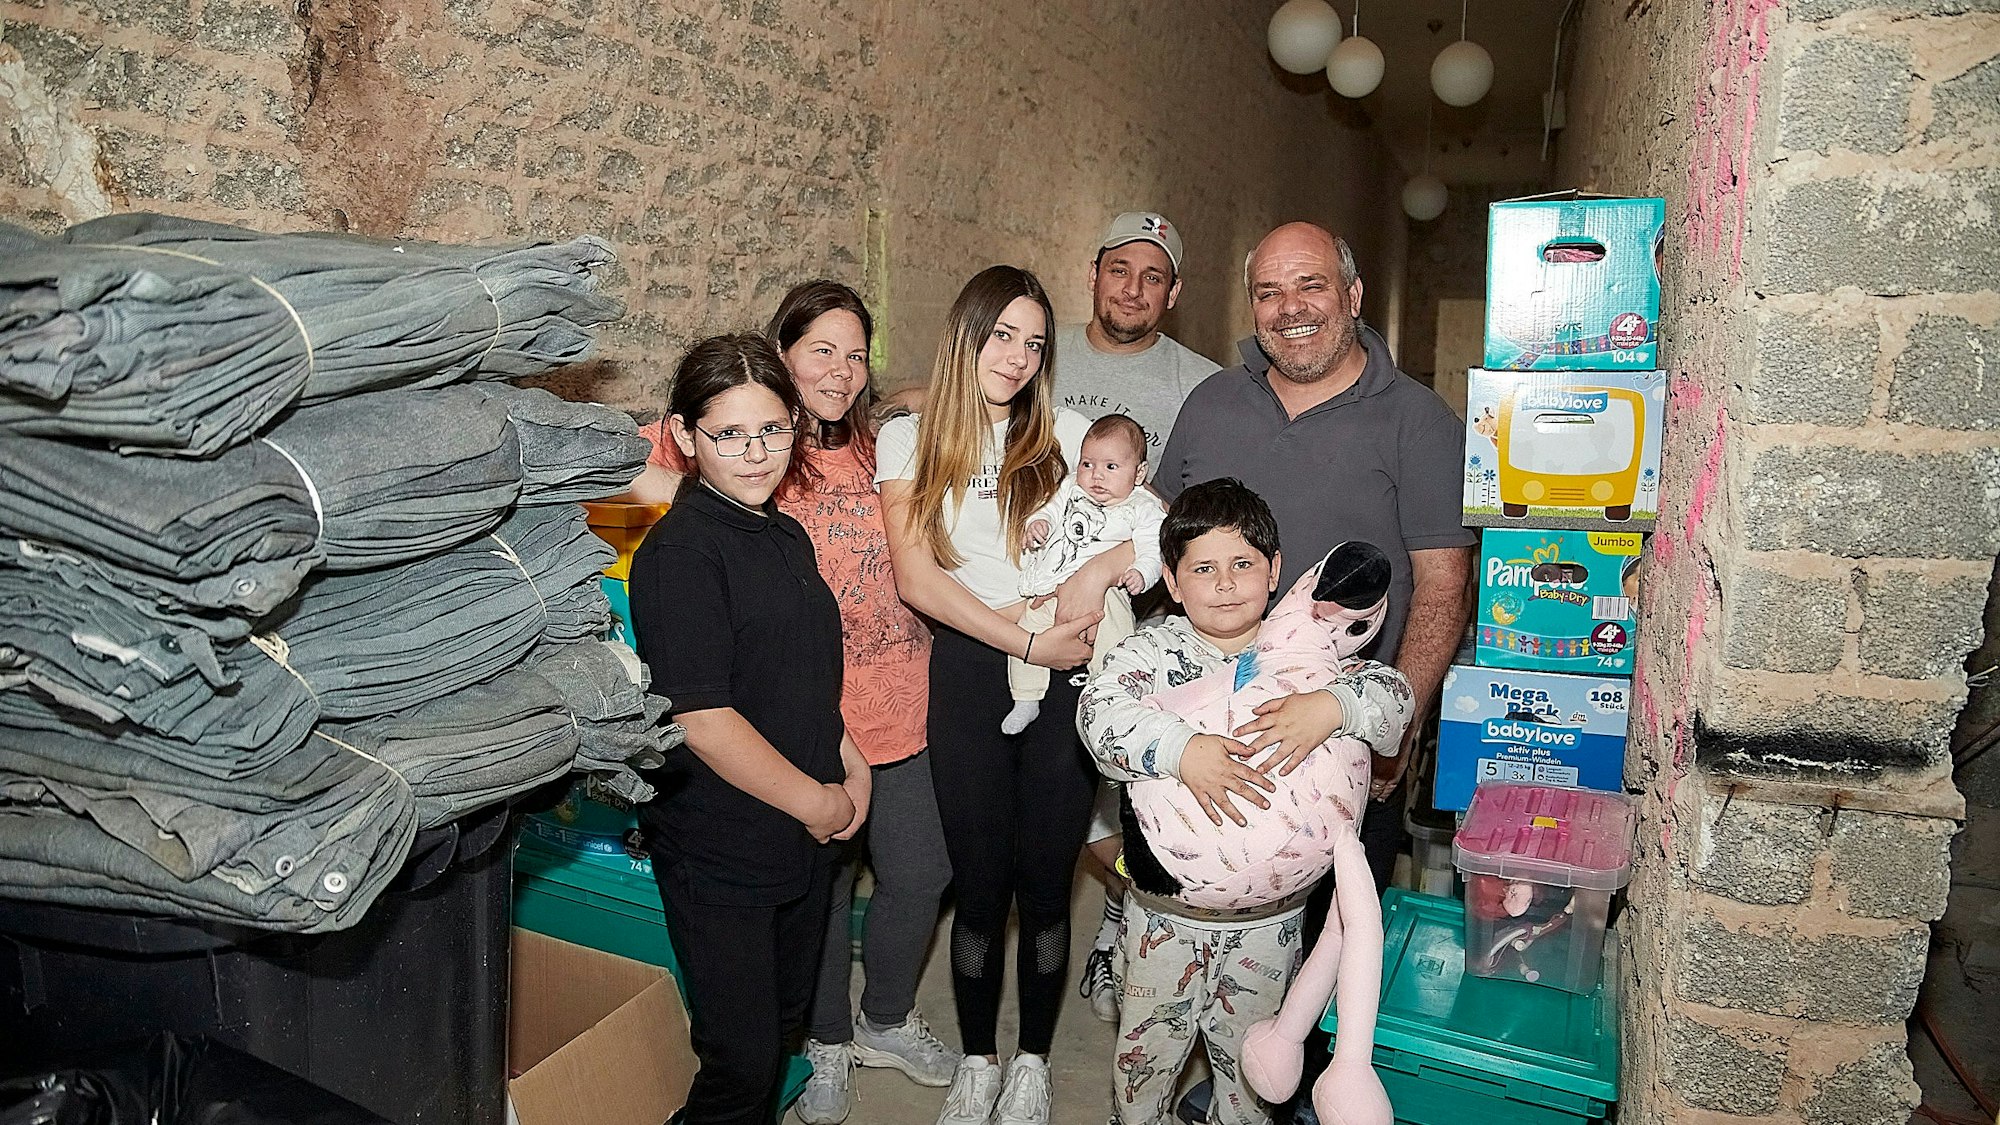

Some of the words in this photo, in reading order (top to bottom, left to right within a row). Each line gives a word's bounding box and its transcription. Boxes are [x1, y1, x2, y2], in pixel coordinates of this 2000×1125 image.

[1611, 351, 1636, 363] 104
[1064, 394, 1109, 408] MAKE
[1114, 403, 1131, 415] IT
[1593, 536, 1635, 547] Jumbo
[1486, 556, 1587, 597] Pamp
[1539, 589, 1588, 607] Baby-Dry
[1597, 656, 1613, 667] 74
[1490, 683, 1549, 706] Mega
[1590, 691, 1623, 703] 108
[1600, 702, 1626, 711] Stück
[1572, 711, 1586, 721] dm
[1487, 721, 1576, 745] babylove
[1507, 746, 1531, 754] aktiv
[1532, 747, 1551, 757] plus
[1496, 752, 1562, 766] Premium-Windeln
[1485, 761, 1498, 776] 5
[1511, 770, 1526, 781] 3x
[582, 839, 604, 852] unicef
[629, 860, 643, 873] 74
[1238, 956, 1284, 982] MARVEL
